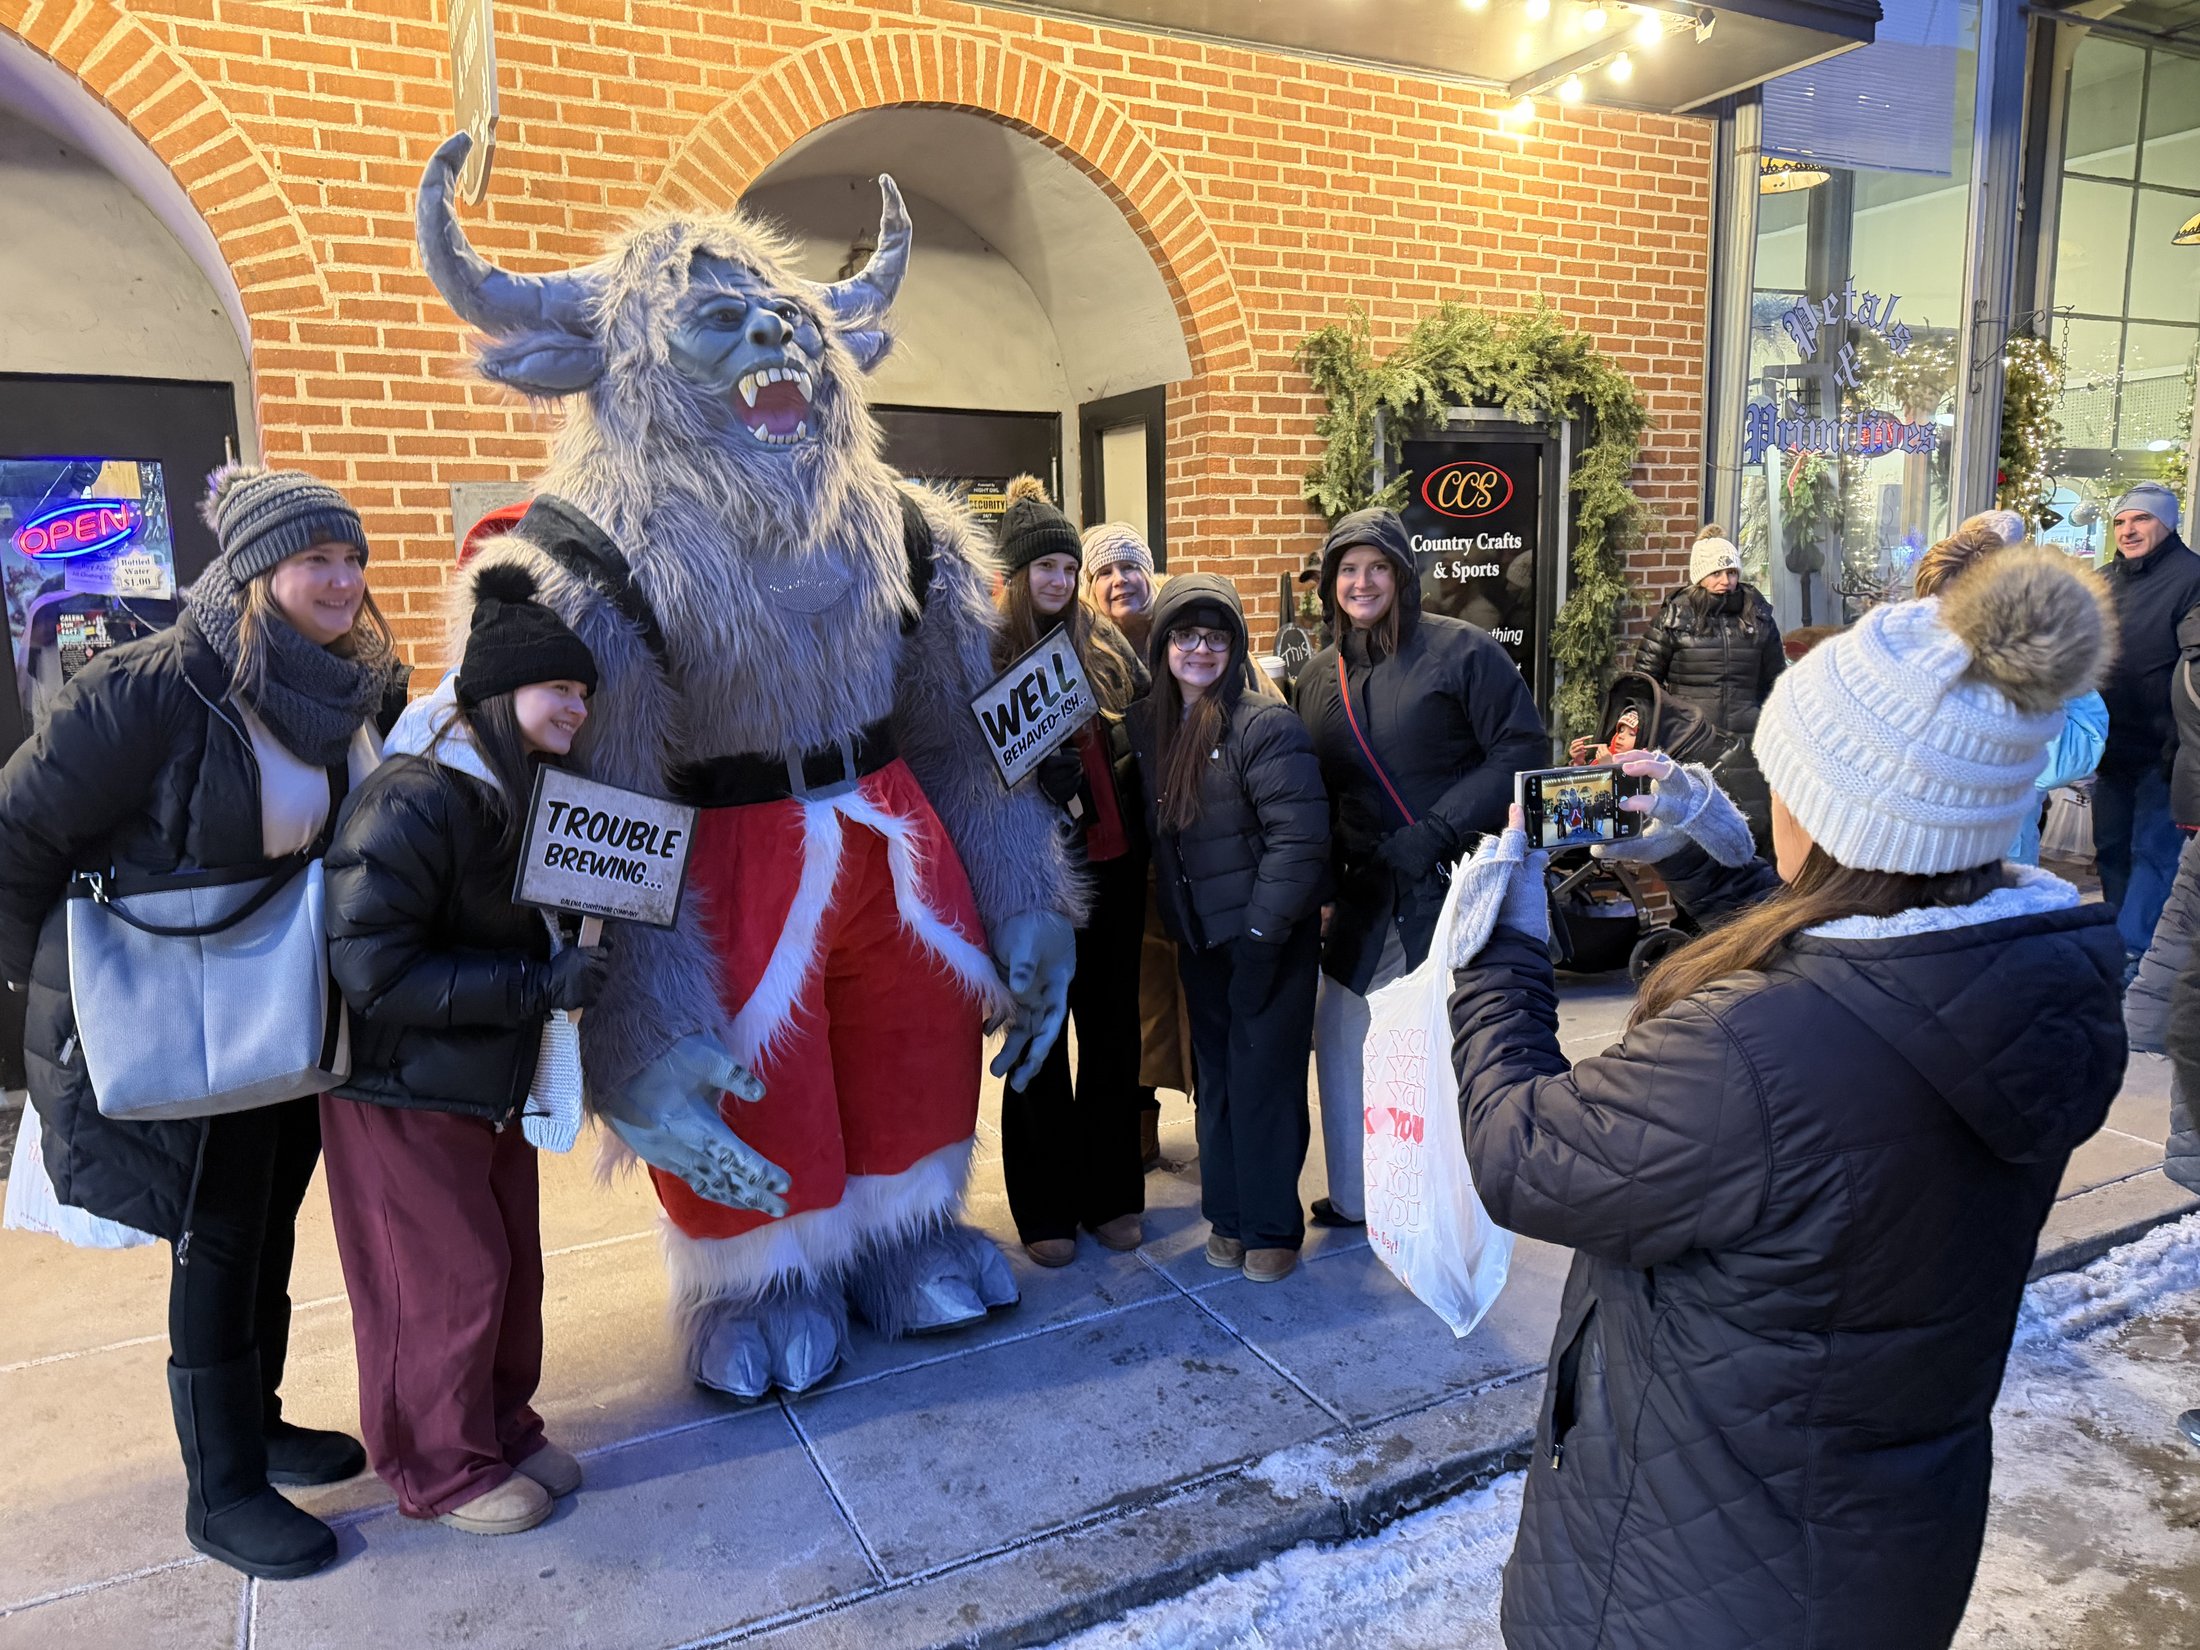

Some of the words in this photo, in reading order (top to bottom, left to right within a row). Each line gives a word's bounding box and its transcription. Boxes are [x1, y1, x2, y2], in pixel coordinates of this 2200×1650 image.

[1782, 275, 1913, 361] Petals
[1833, 341, 1862, 388] &
[1745, 403, 1937, 464] Primitives
[968, 500, 1005, 510] SECURITY
[1438, 470, 1498, 509] CCS
[18, 503, 130, 555] OPEN
[1410, 534, 1473, 556] Country
[1476, 531, 1522, 550] Crafts
[121, 558, 151, 567] Bottled
[124, 567, 150, 575] Water
[1433, 561, 1449, 580] &
[1451, 560, 1500, 583] Sports
[123, 577, 151, 587] $1.00
[1488, 626, 1524, 646] thing
[981, 652, 1078, 748] WELL
[547, 800, 682, 859] TROUBLE
[544, 842, 662, 889] BREWING...
[1387, 1107, 1424, 1144] YOU
